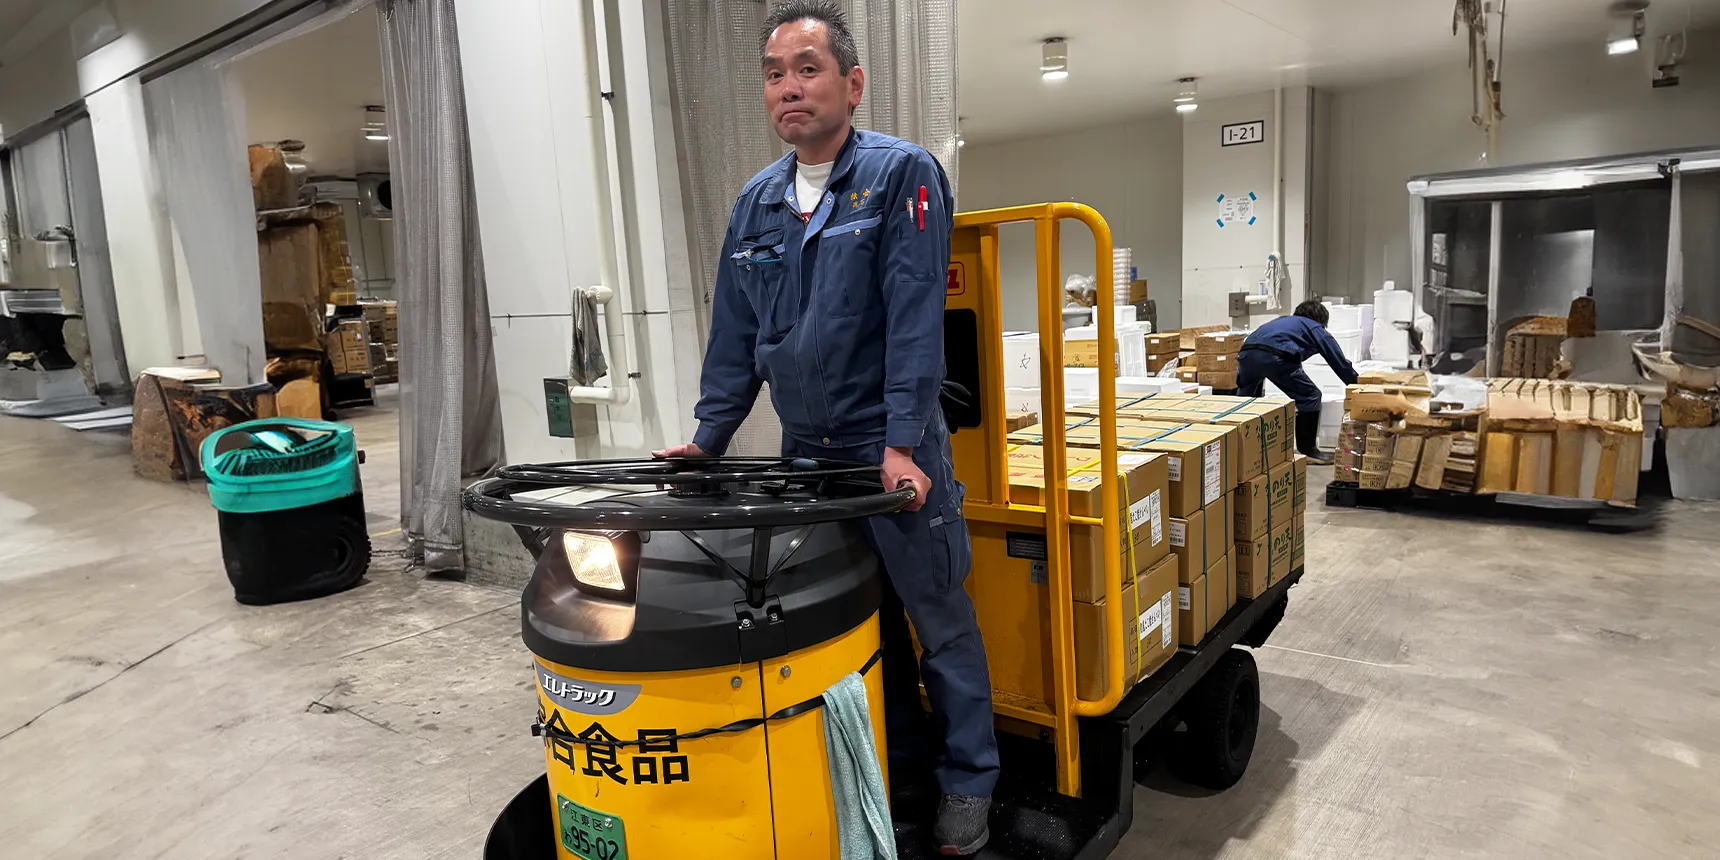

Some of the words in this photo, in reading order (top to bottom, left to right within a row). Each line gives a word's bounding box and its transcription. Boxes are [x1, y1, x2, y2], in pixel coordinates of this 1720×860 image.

[1229, 126, 1255, 141] I-21
[543, 673, 616, 706] エレトラック
[570, 808, 603, 832] 江東区
[571, 825, 619, 860] 95-02
